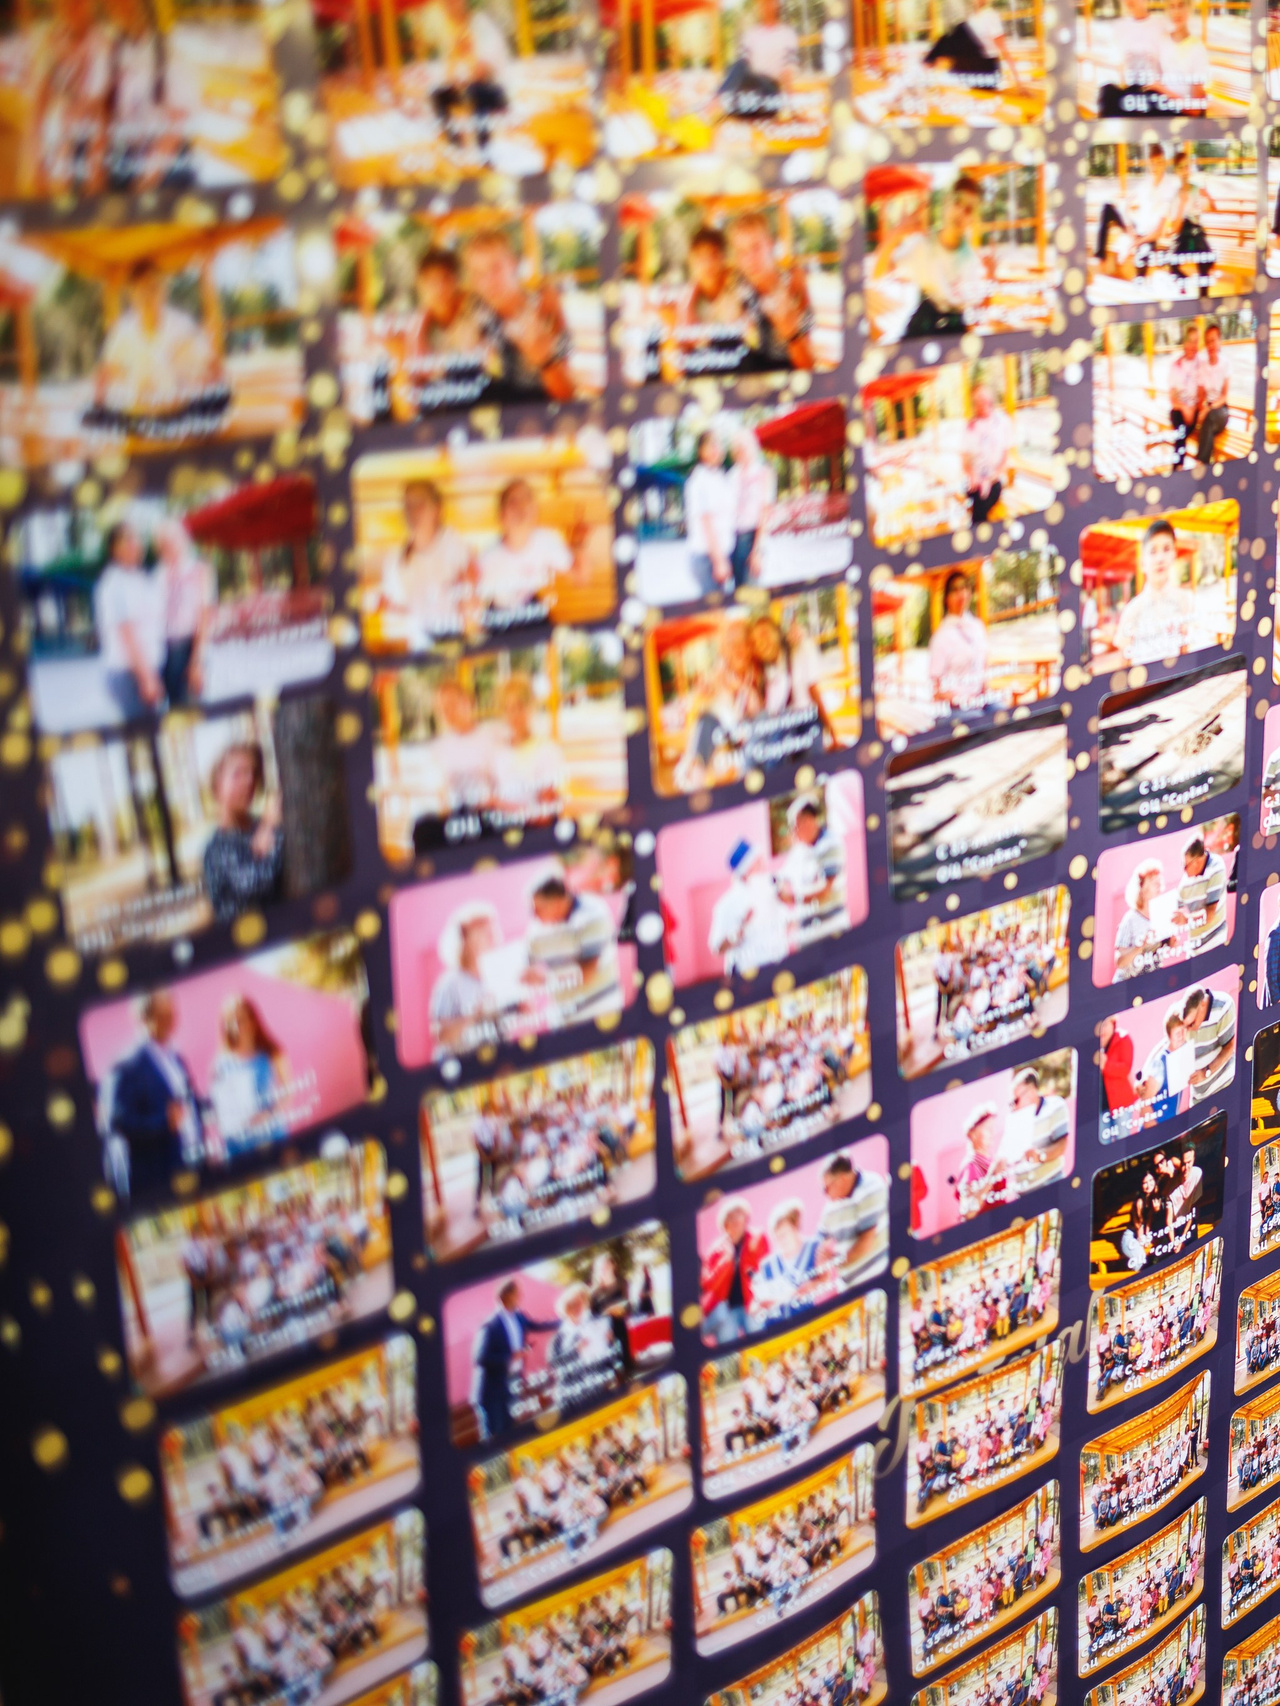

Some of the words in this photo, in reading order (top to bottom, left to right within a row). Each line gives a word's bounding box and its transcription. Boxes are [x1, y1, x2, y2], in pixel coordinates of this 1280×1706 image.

[1252, 1241, 1268, 1255] ОЦ
[1261, 1475, 1274, 1487] ОЦ
[1122, 1512, 1138, 1526] ОЦ
[1223, 1610, 1238, 1626] ОЦ
[915, 1654, 935, 1672] ОЦ
[1080, 1654, 1099, 1674] ОЦ
